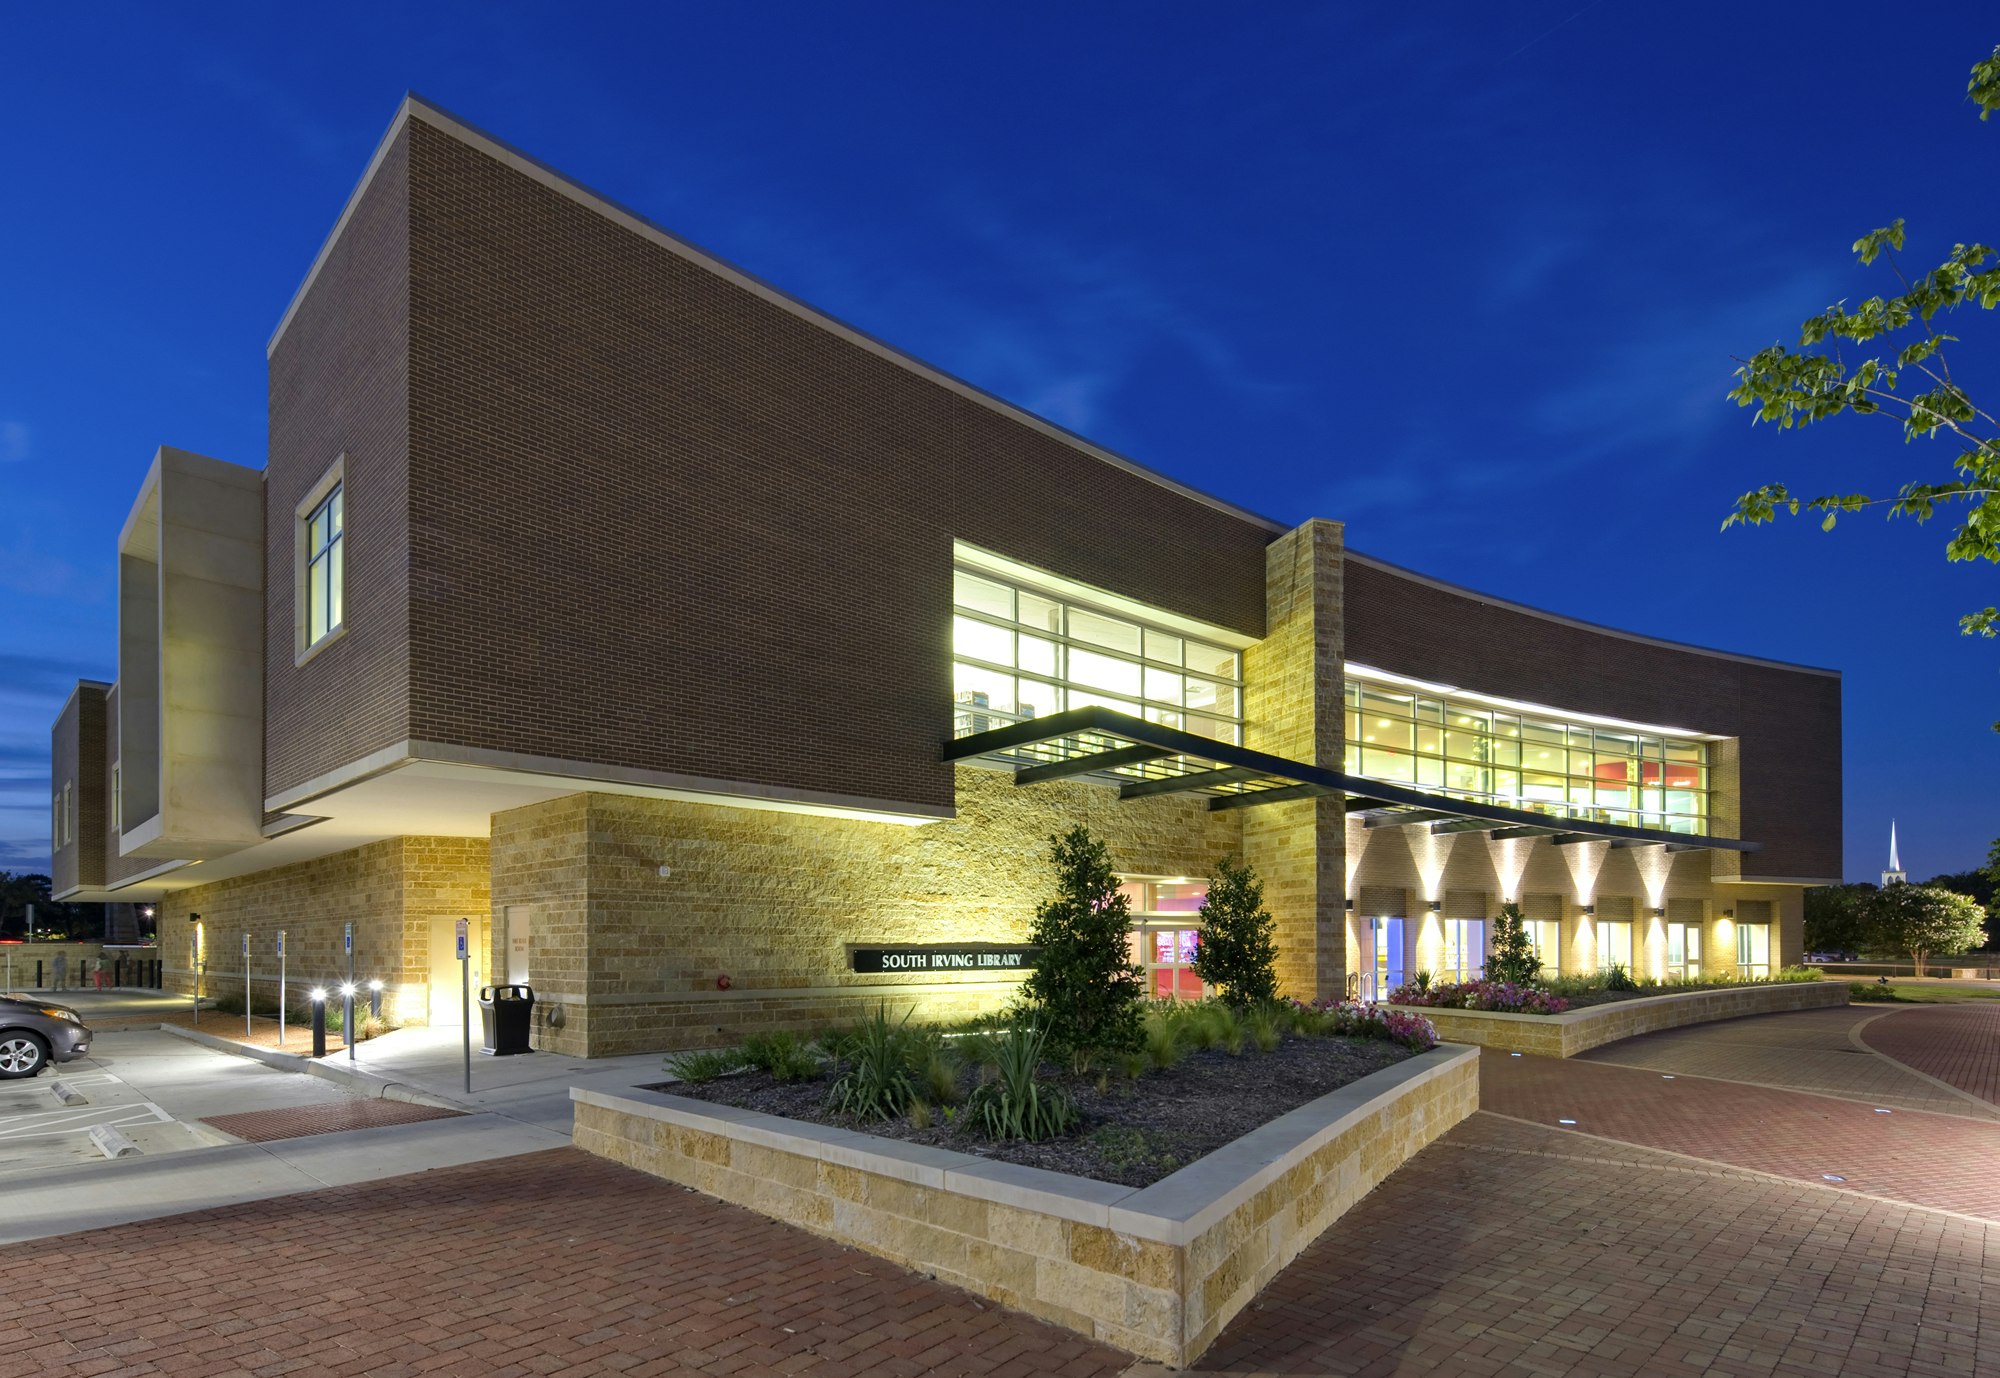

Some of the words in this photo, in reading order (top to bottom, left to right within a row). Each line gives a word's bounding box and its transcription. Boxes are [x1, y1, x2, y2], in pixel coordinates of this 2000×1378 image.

[882, 954, 927, 968] SOUTH
[931, 954, 974, 967] IRVING
[977, 953, 1022, 966] LIBRARY
